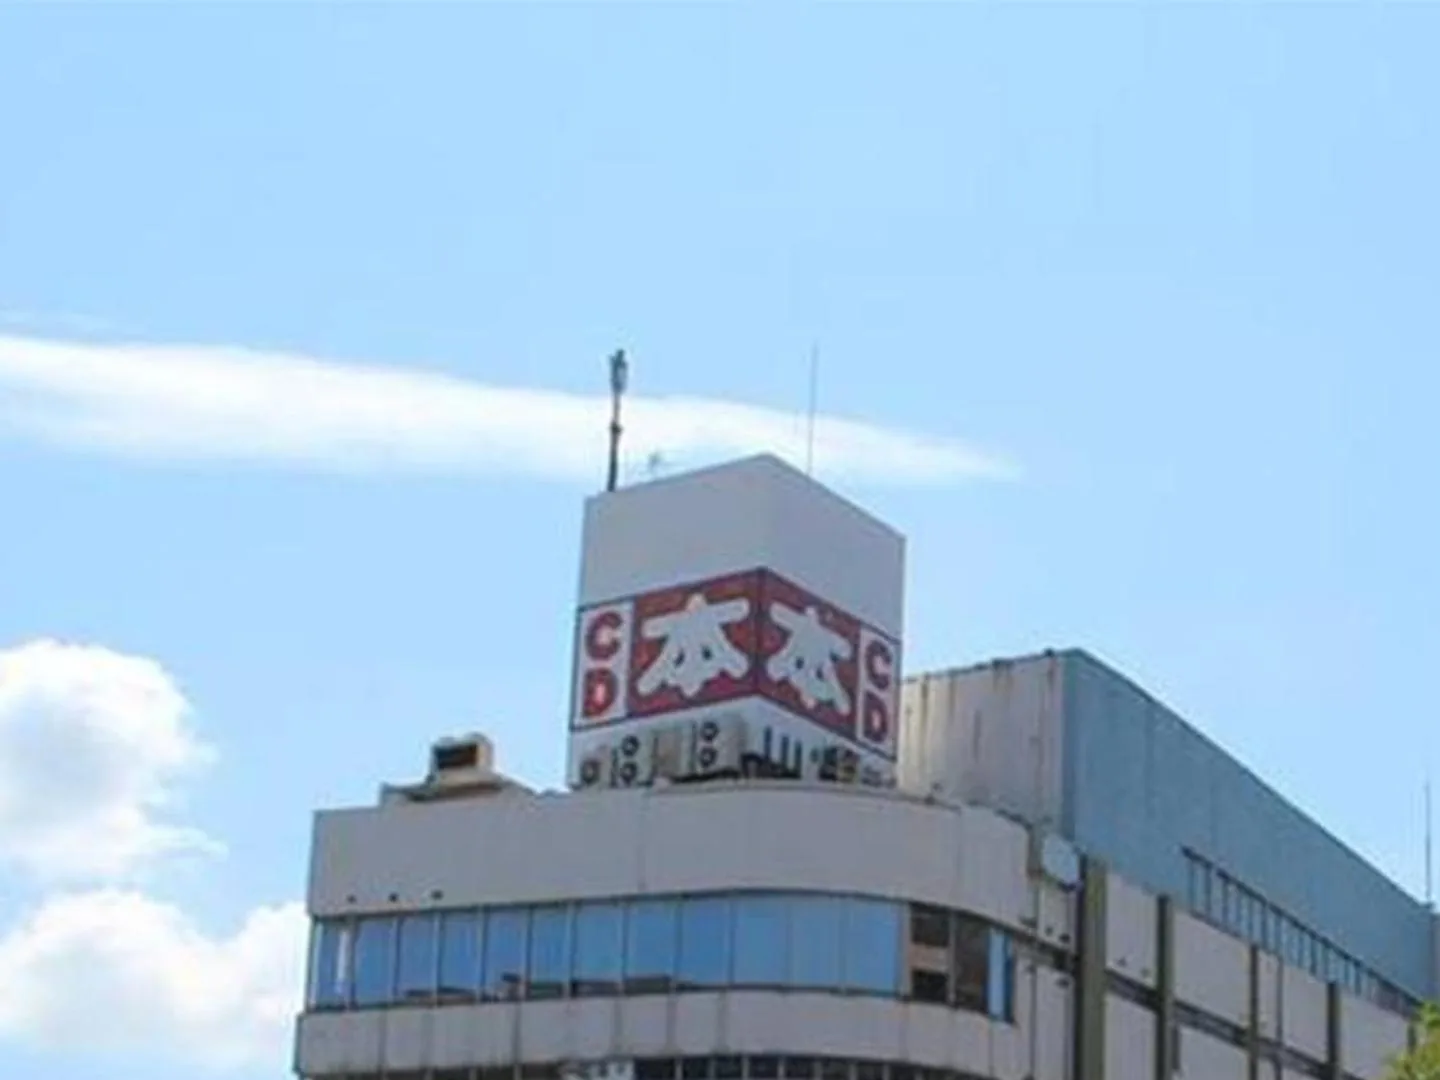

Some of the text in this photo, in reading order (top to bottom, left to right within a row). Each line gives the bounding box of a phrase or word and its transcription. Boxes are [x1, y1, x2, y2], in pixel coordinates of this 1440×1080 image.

[585, 611, 621, 717] CD
[637, 593, 749, 697] 本
[765, 602, 851, 716] 本
[863, 639, 892, 743] CD
